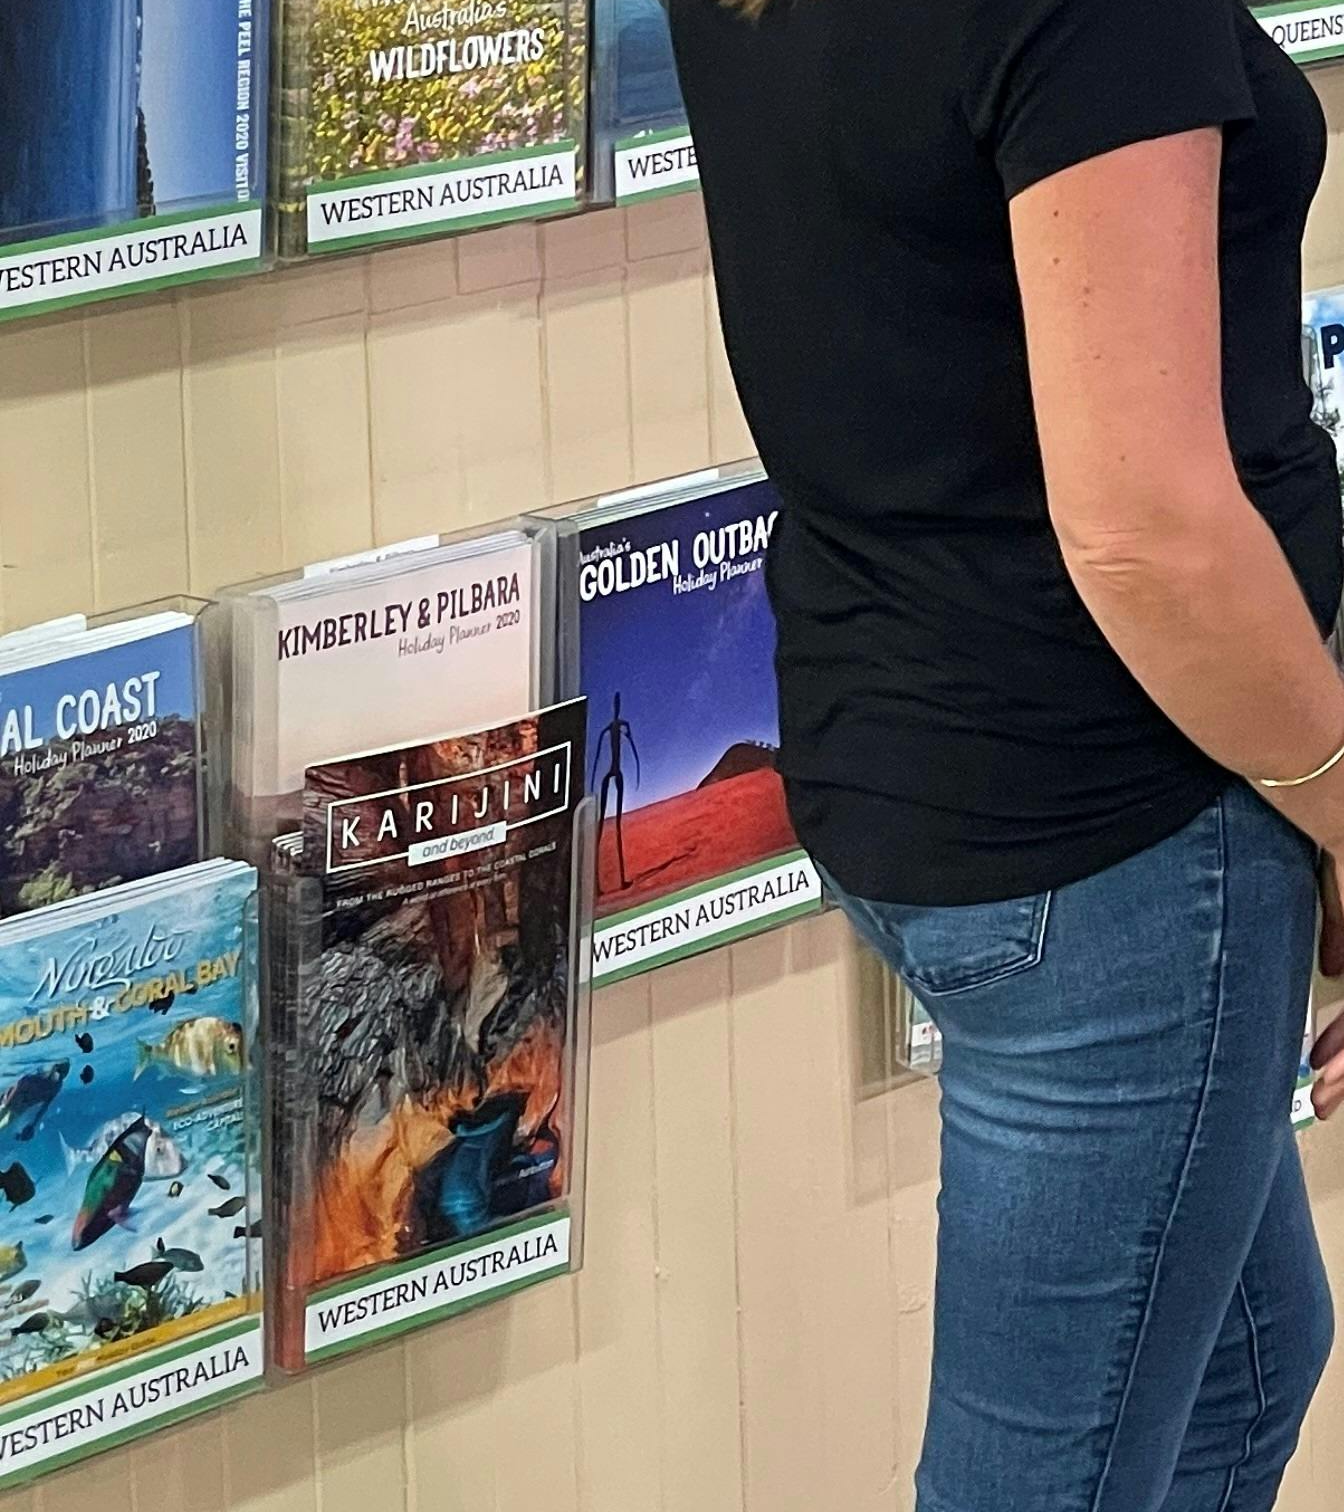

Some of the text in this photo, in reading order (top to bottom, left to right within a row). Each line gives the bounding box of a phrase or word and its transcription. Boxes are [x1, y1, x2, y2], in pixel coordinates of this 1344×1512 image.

[369, 28, 546, 83] WILDFLOWERS
[235, 112, 249, 150] 2020
[320, 164, 564, 226] WESTERN AUSTRALIA
[108, 223, 249, 274] AUSTRALIA
[579, 540, 680, 602] GOLDEN
[673, 557, 764, 596] Holiday Planner
[278, 571, 521, 660] KIMBERLEY & PILBARA
[398, 609, 521, 658] Holiday Planner 2020
[57, 670, 162, 739] COAST
[14, 721, 157, 775] Holiday Planner 2020
[341, 764, 562, 850] KARIJINI
[422, 826, 496, 858] and beyond
[593, 867, 811, 965] WESTERN AUSTRALIA
[113, 946, 242, 1014] CORAL BAY
[317, 1233, 560, 1334] WESTERN AUSTRALIA
[111, 1345, 250, 1419] AUSTRALIA
